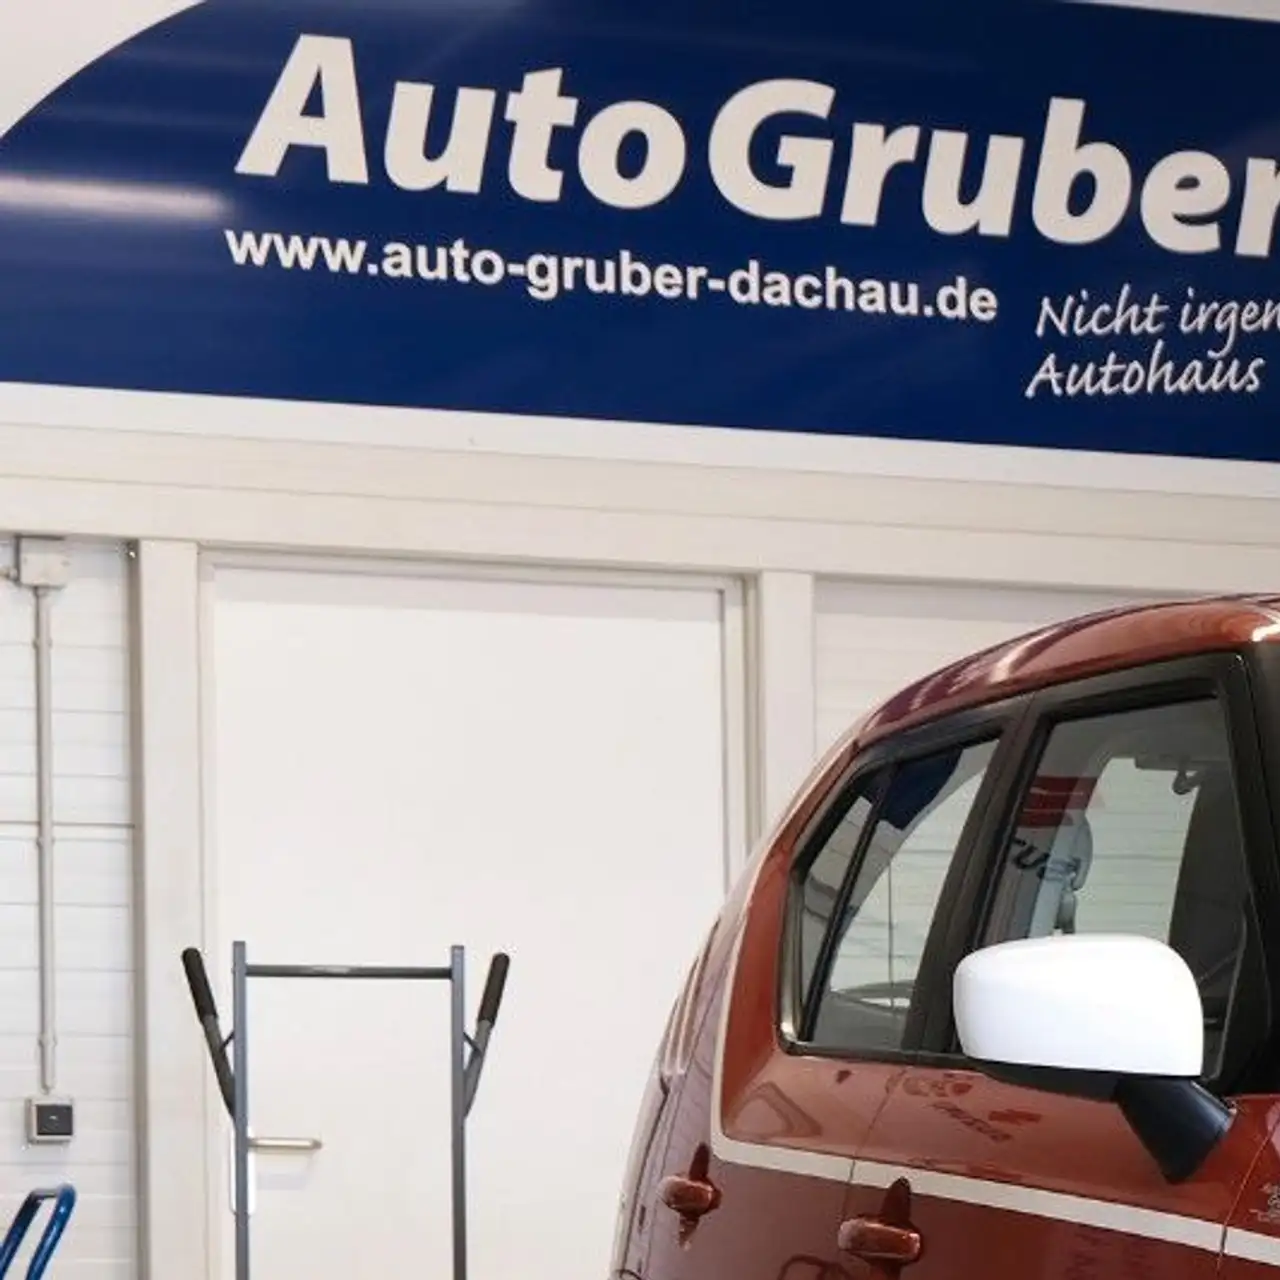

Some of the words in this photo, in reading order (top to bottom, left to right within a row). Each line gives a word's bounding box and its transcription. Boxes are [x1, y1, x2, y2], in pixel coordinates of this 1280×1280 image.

[224, 228, 998, 322] www.auto-gruber-dachau.de
[1035, 284, 1168, 337] Nicht
[1024, 339, 1266, 398] Autohaus
